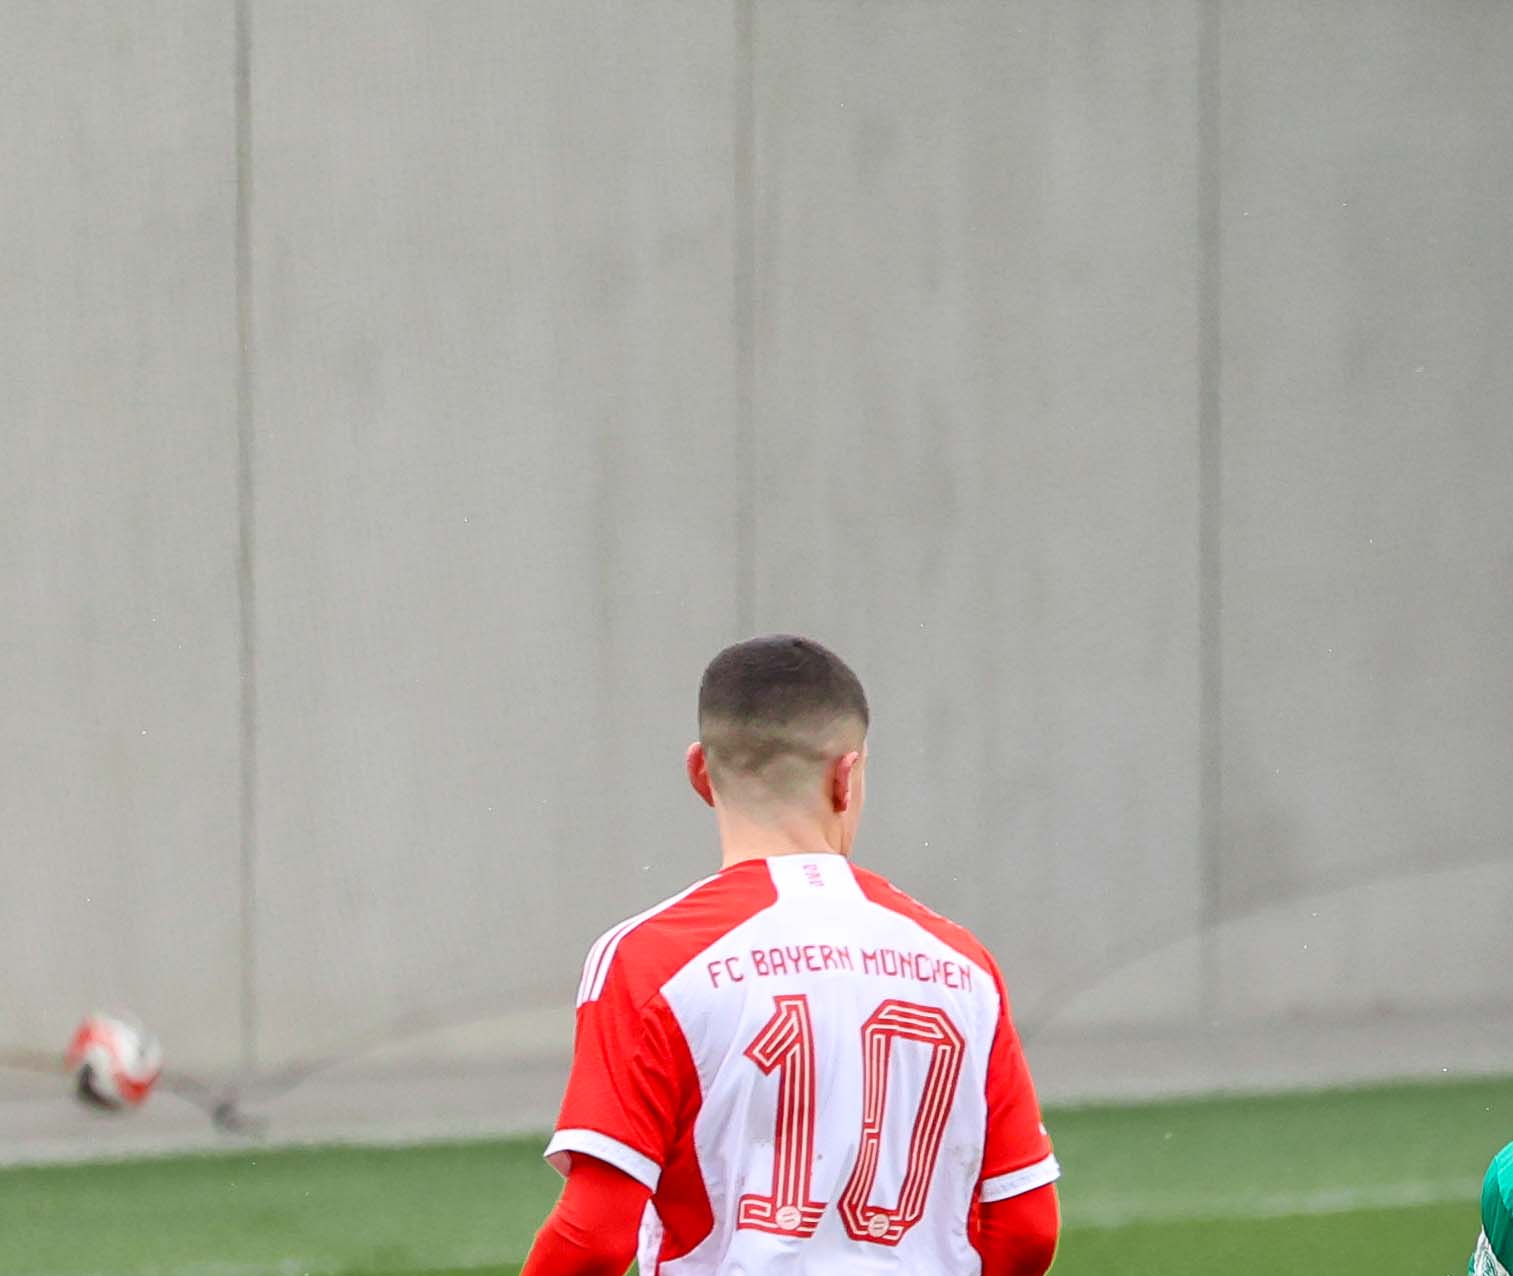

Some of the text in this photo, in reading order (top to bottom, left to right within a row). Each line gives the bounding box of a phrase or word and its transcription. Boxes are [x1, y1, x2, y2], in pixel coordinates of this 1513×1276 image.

[708, 944, 974, 993] FC BAYERN MÜNCHEN
[737, 993, 967, 1248] 10
